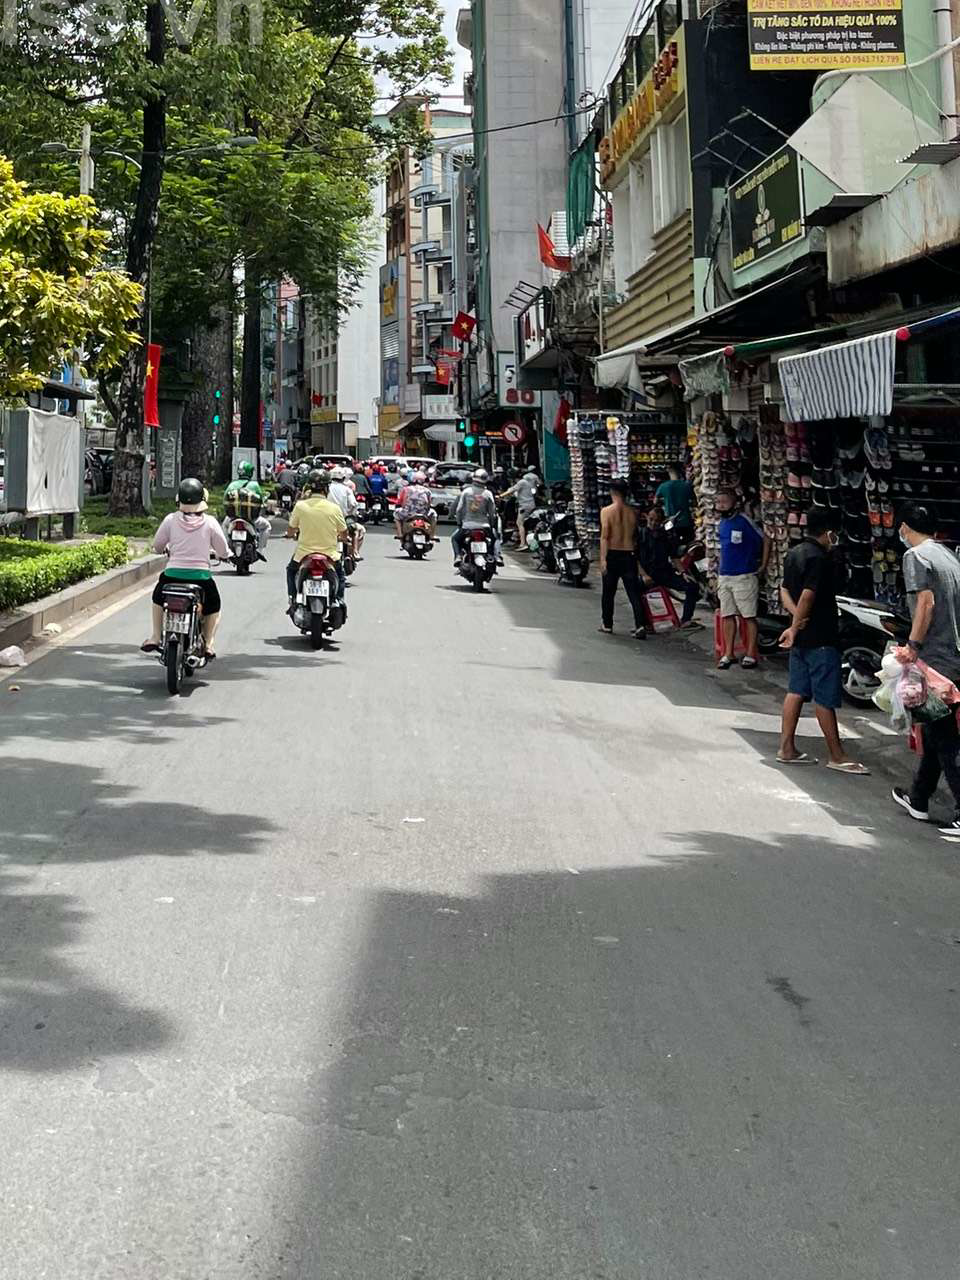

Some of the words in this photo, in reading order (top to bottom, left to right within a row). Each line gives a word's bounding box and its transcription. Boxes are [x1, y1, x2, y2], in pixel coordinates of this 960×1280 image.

[753, 16, 766, 29] TRỊ
[791, 14, 808, 26] SẮC
[822, 16, 834, 26] DA
[875, 15, 897, 26] 100%
